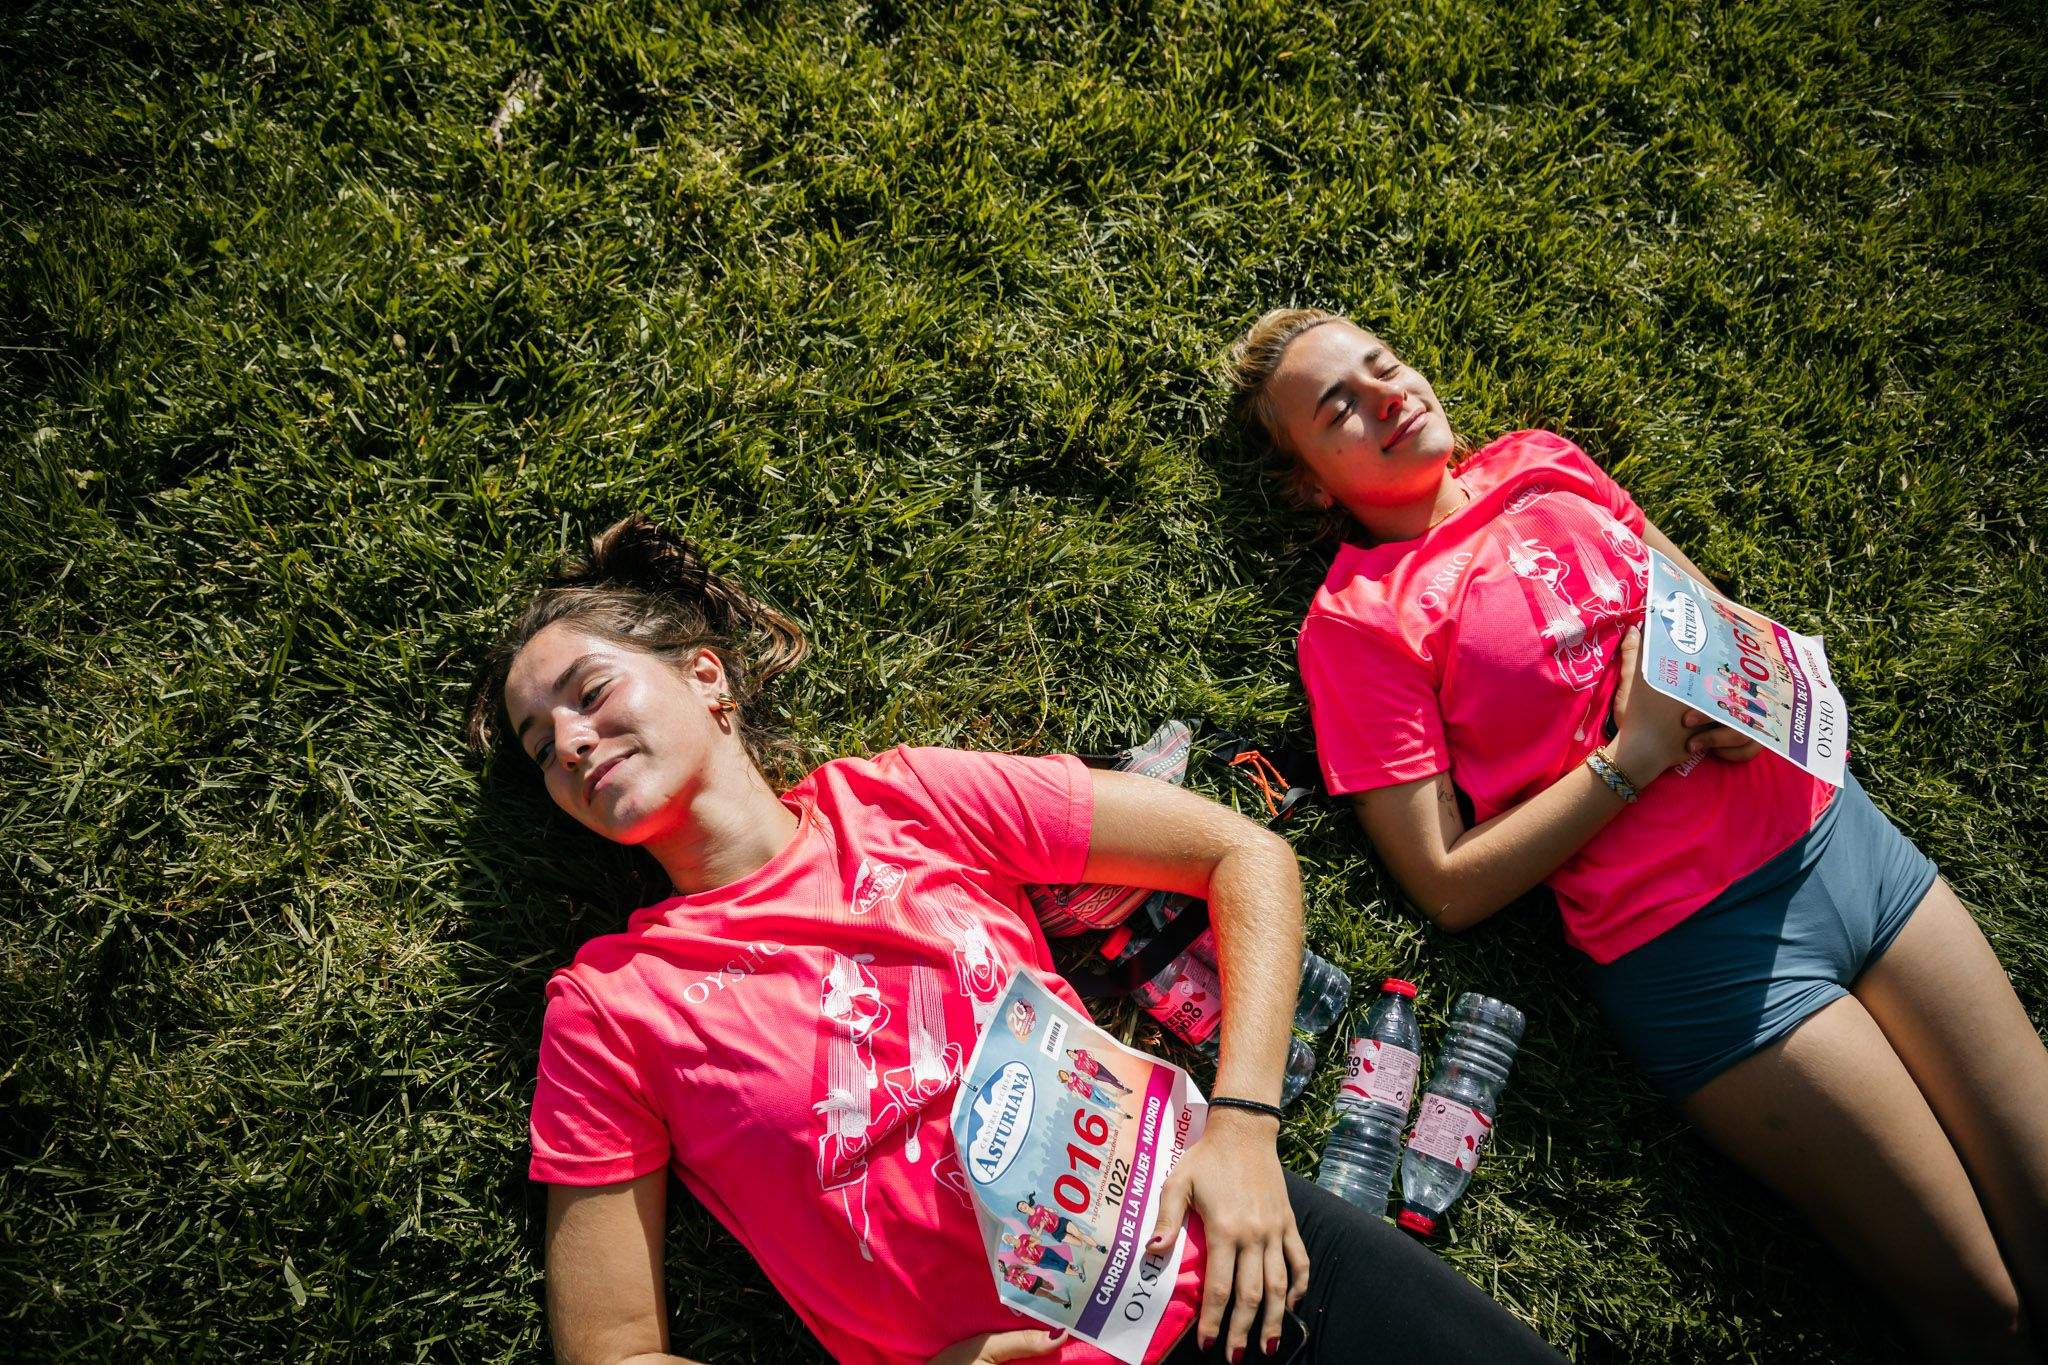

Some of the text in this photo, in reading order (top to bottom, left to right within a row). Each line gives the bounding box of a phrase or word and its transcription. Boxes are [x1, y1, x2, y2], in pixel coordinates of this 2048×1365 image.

[1418, 552, 1473, 610] OYSHO
[1733, 627, 1770, 682] 016
[1793, 702, 1807, 744] CARRERA
[1797, 689, 1808, 702] DE
[1816, 700, 1834, 758] OYSHO
[976, 1072, 1030, 1178] ASTURIANA
[1053, 1107, 1109, 1215] 016
[1105, 1158, 1131, 1208] 1022
[1096, 1096, 1161, 1306] CARRERA DE LA MUJER MADRID
[1124, 1253, 1164, 1322] OYSH
